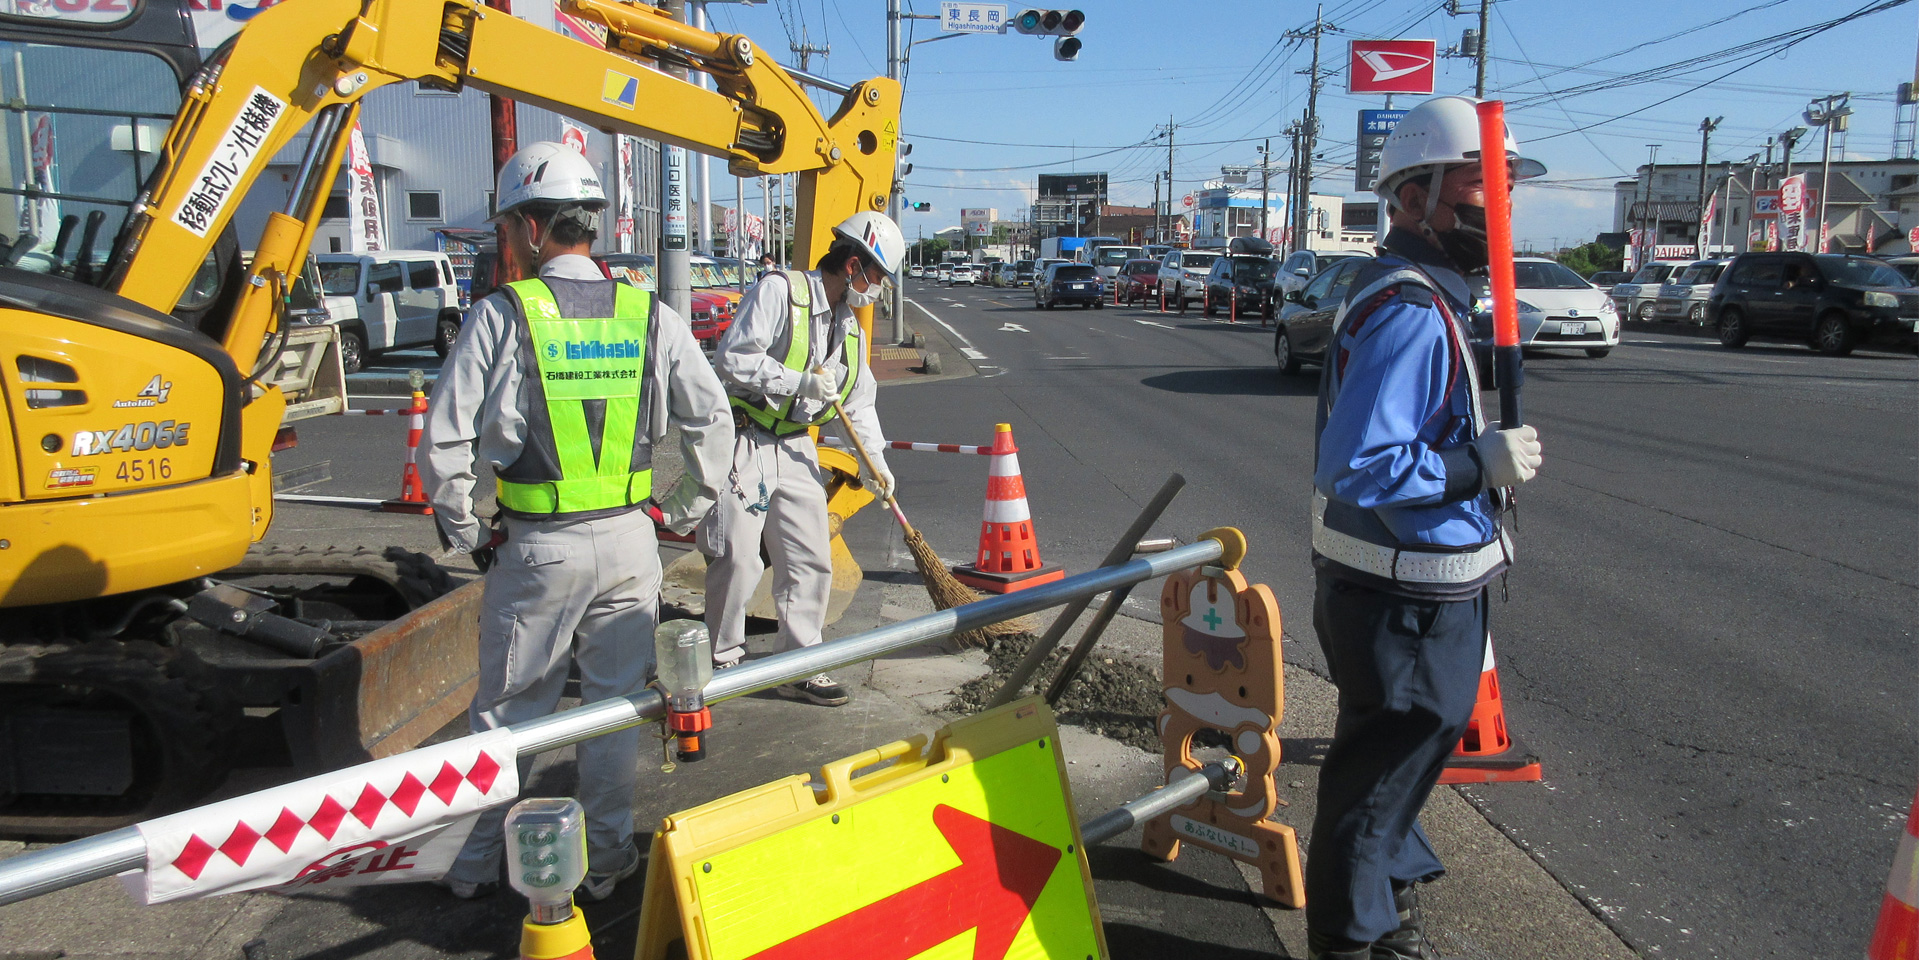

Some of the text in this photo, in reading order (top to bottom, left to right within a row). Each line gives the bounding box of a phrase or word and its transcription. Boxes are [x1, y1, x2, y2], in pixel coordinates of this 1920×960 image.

[948, 9, 1000, 22] 東長岡
[948, 22, 1000, 31] Higashinagaoka
[178, 93, 281, 232] 移動式クレーン仕様機
[668, 155, 681, 211] 山口医院
[1655, 246, 1694, 257] DAIHAT
[565, 340, 640, 359] Ishibashi
[546, 369, 637, 380] 石橋建設工業株式会社
[112, 399, 156, 408] AutoIdle
[71, 420, 191, 457] RX406E
[116, 458, 172, 483] 4516
